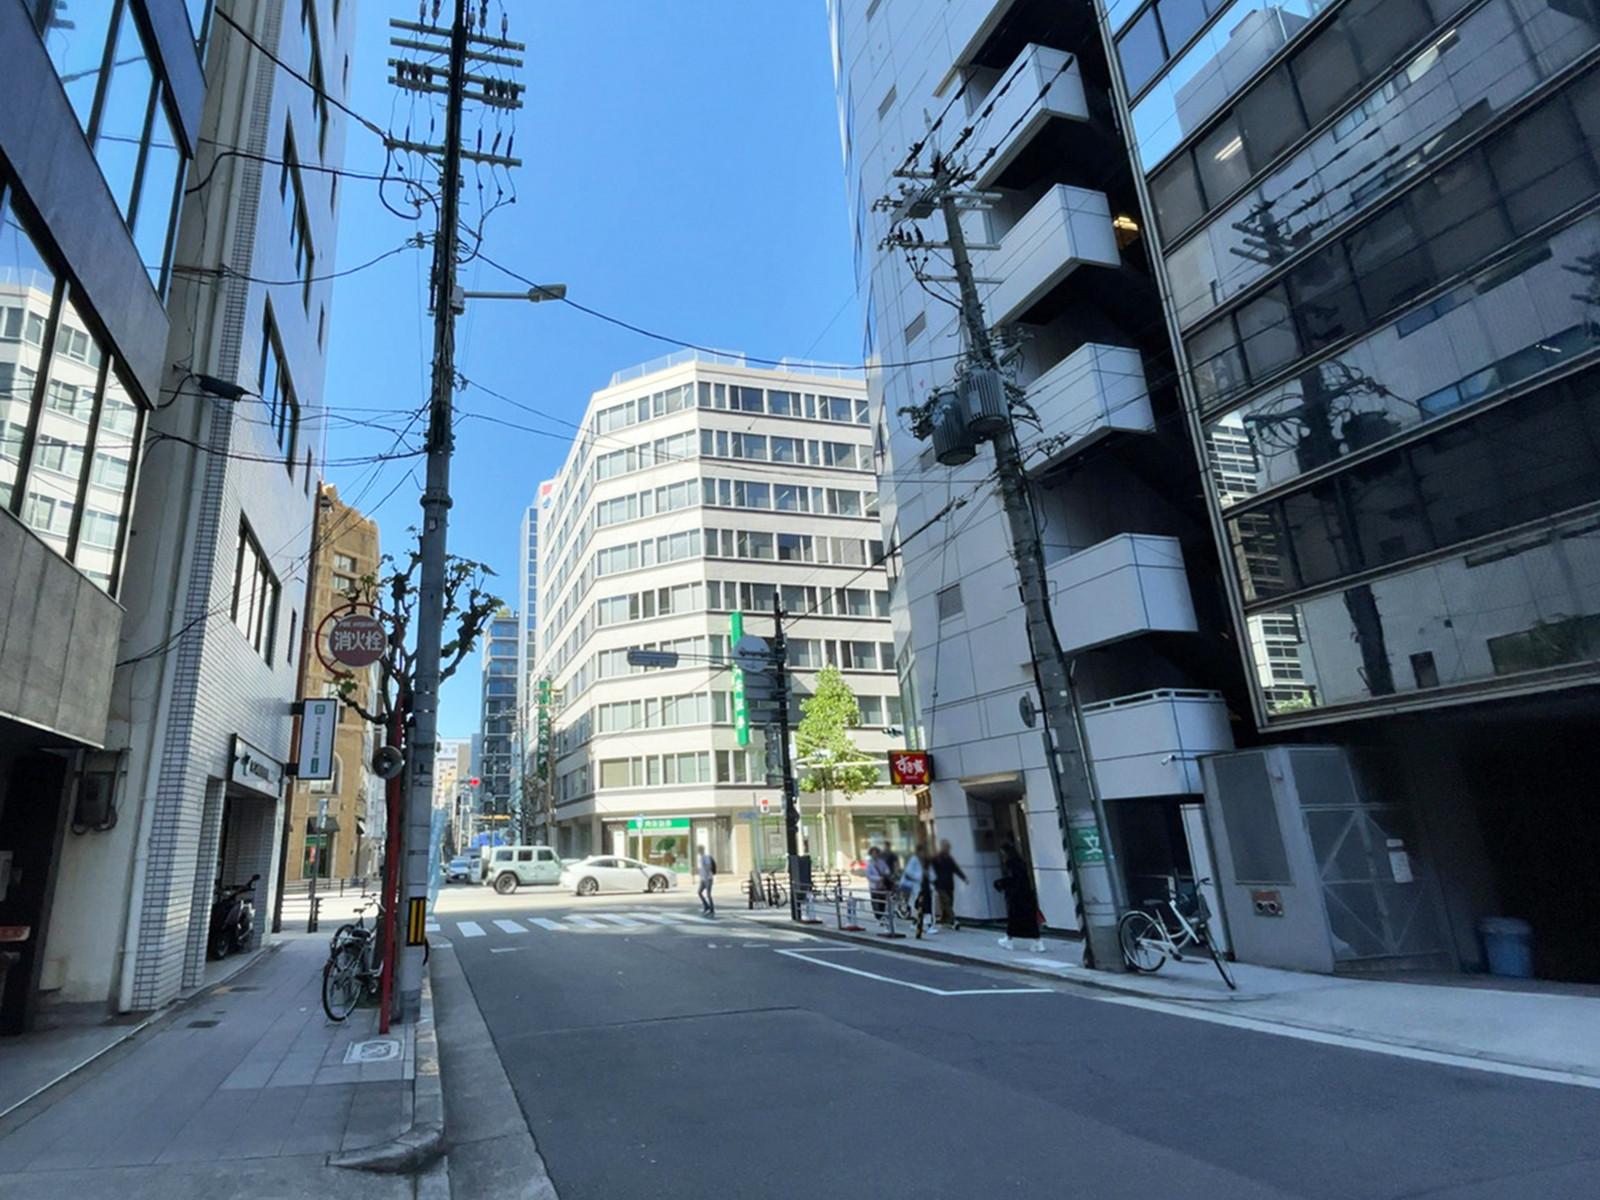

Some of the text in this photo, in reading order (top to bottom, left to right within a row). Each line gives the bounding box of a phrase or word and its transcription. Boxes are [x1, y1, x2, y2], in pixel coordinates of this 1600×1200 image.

[334, 630, 383, 651] 消火栓
[895, 754, 925, 776] すき家
